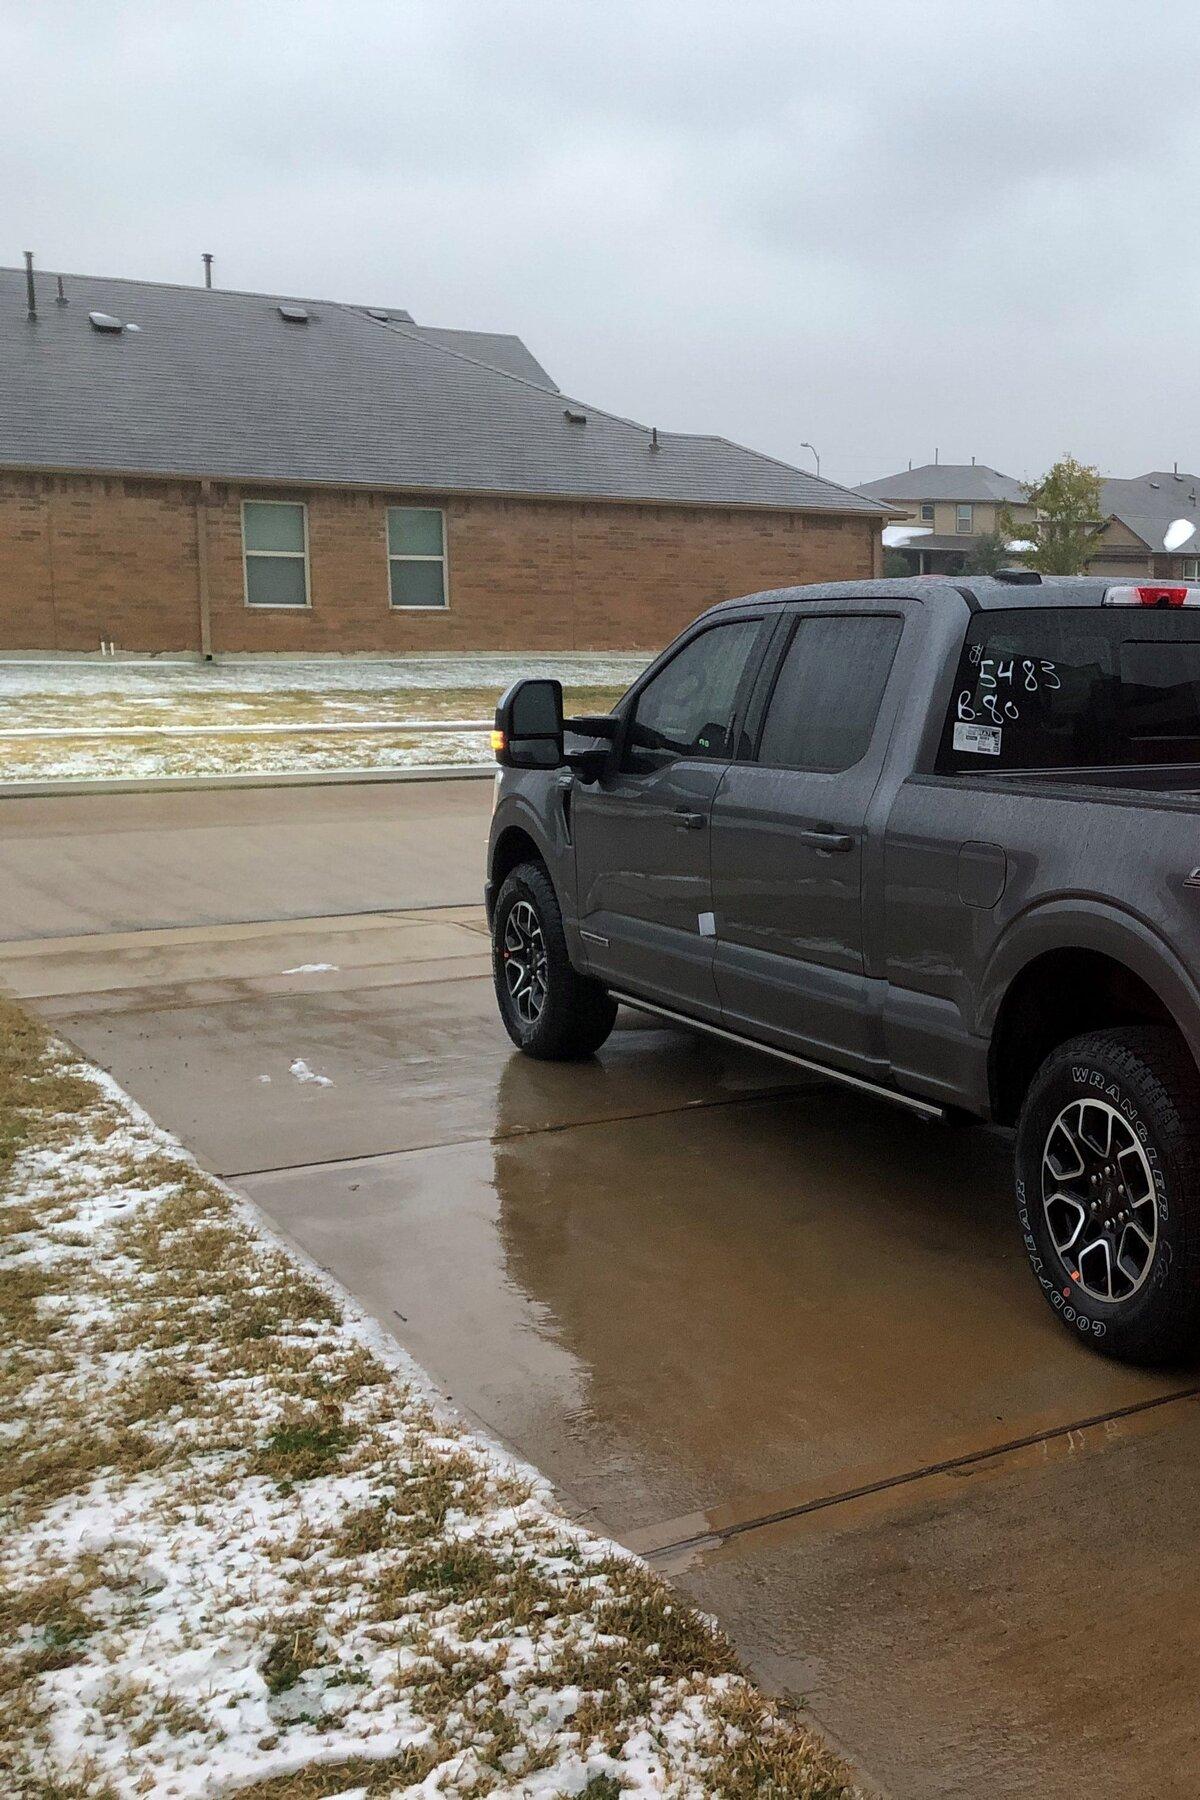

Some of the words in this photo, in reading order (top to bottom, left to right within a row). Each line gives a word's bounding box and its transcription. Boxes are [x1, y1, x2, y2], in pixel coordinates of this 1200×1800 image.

[979, 660, 1061, 691] 5483
[1072, 1067, 1168, 1221] WRANGLER
[1016, 1179, 1107, 1336] GOODYEAR
